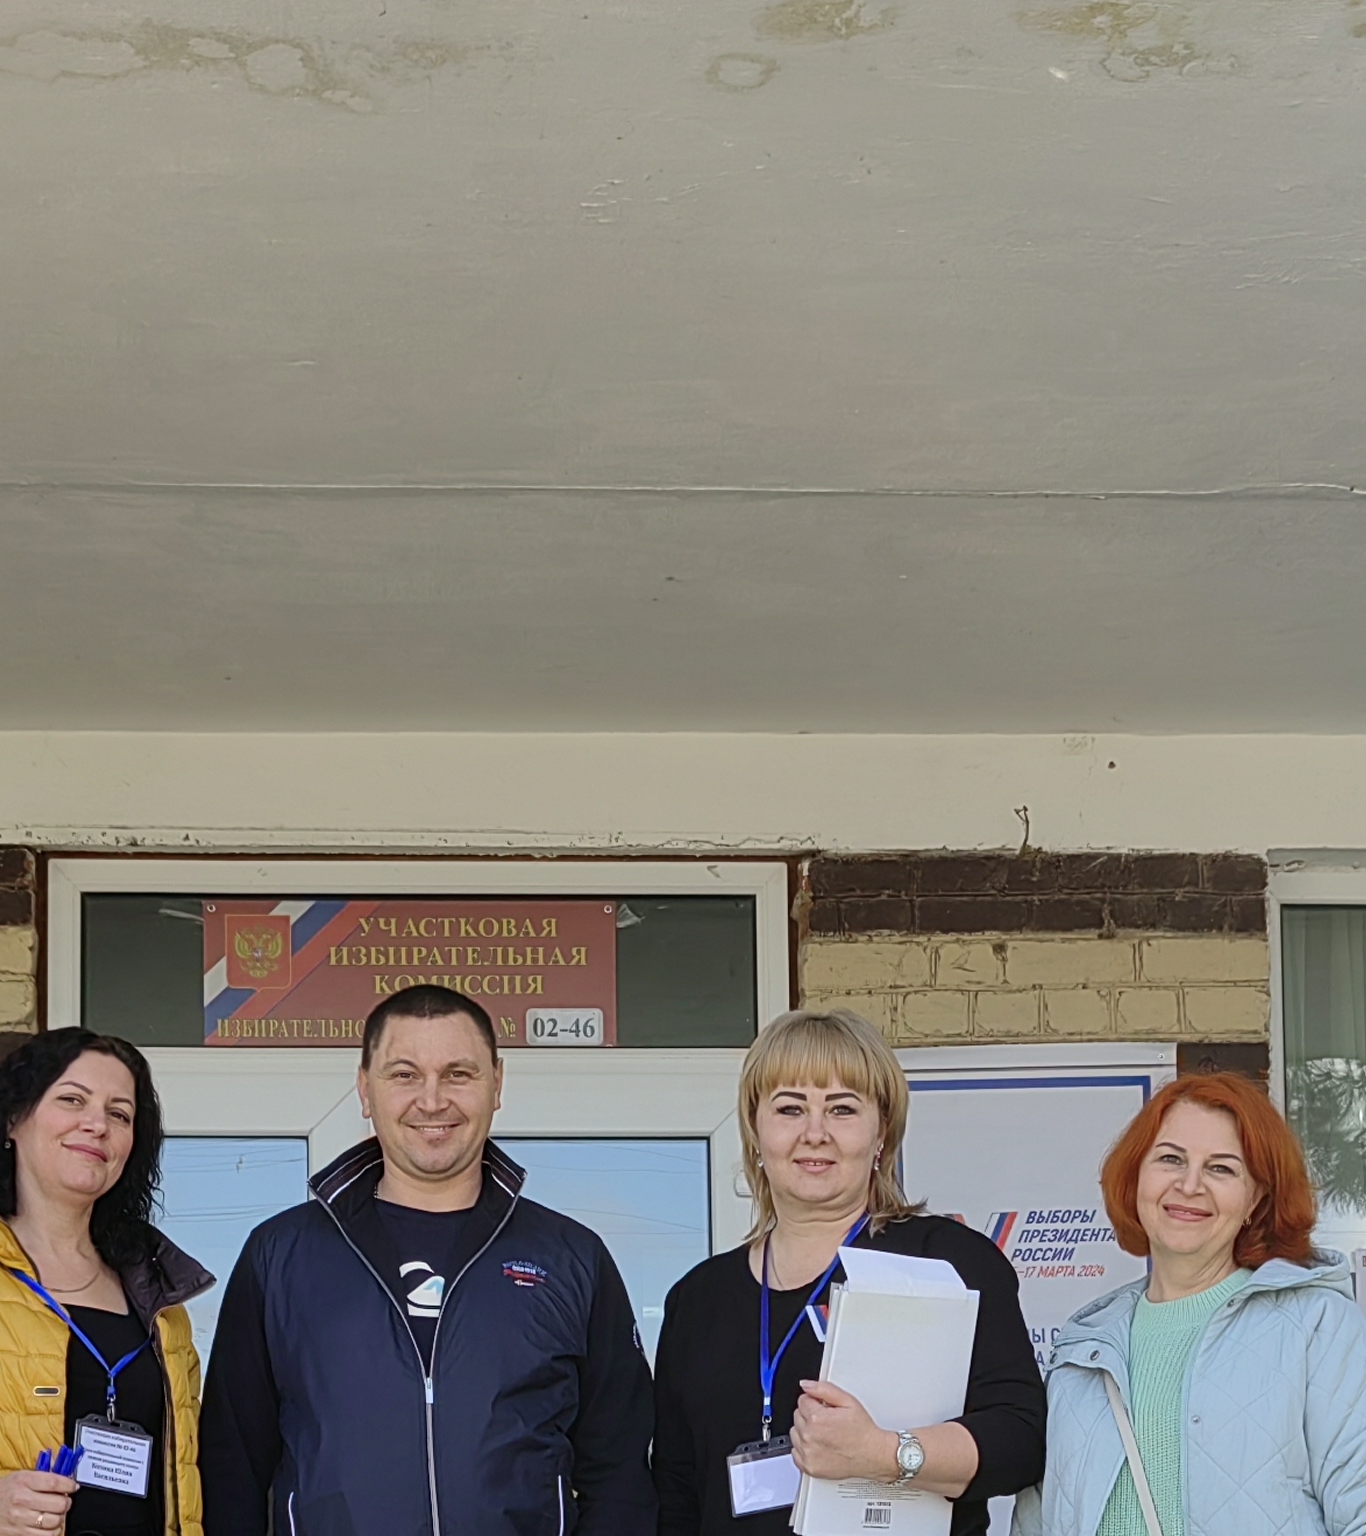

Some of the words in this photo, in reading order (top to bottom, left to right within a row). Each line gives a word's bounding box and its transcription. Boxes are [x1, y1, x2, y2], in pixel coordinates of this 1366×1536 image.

[358, 917, 559, 939] УЧАСТКОВАЯ
[328, 946, 589, 967] ИЗБИРАТЕЛЬНАЯ
[216, 1018, 366, 1039] ИЗБИРАТЕЛЬНО
[497, 1016, 517, 1039] №
[531, 1016, 597, 1039] 02-46
[1025, 1208, 1097, 1224] ВЫБОРЫ
[1018, 1227, 1116, 1244] ПРЕЗИДЕНТА
[1011, 1246, 1076, 1262] РОССИИ
[1015, 1265, 1036, 1278] –17
[1036, 1264, 1076, 1278] МАРТА
[1076, 1263, 1105, 1277] 2024
